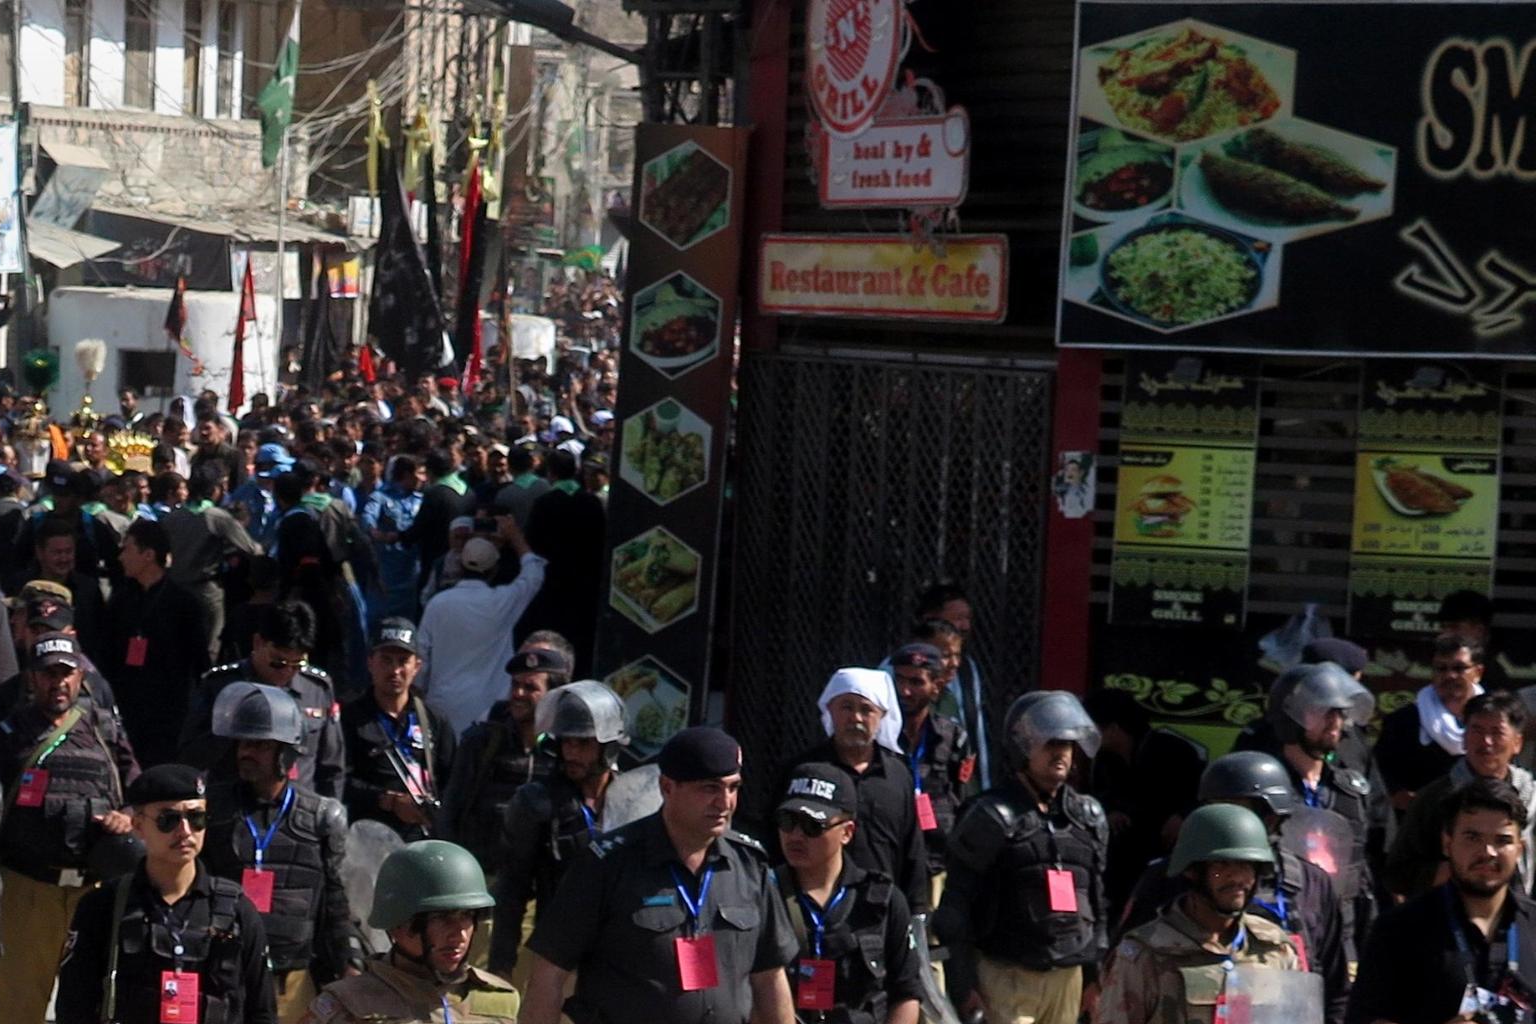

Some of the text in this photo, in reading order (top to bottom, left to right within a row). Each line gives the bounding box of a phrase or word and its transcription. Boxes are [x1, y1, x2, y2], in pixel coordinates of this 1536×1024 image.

[852, 134, 934, 166] healhy &
[851, 168, 933, 189] fresh food
[769, 260, 991, 298] Restaurant & Cafe
[381, 628, 413, 643] POLICE
[36, 639, 73, 657] POLICE
[787, 778, 836, 800] POLICE
